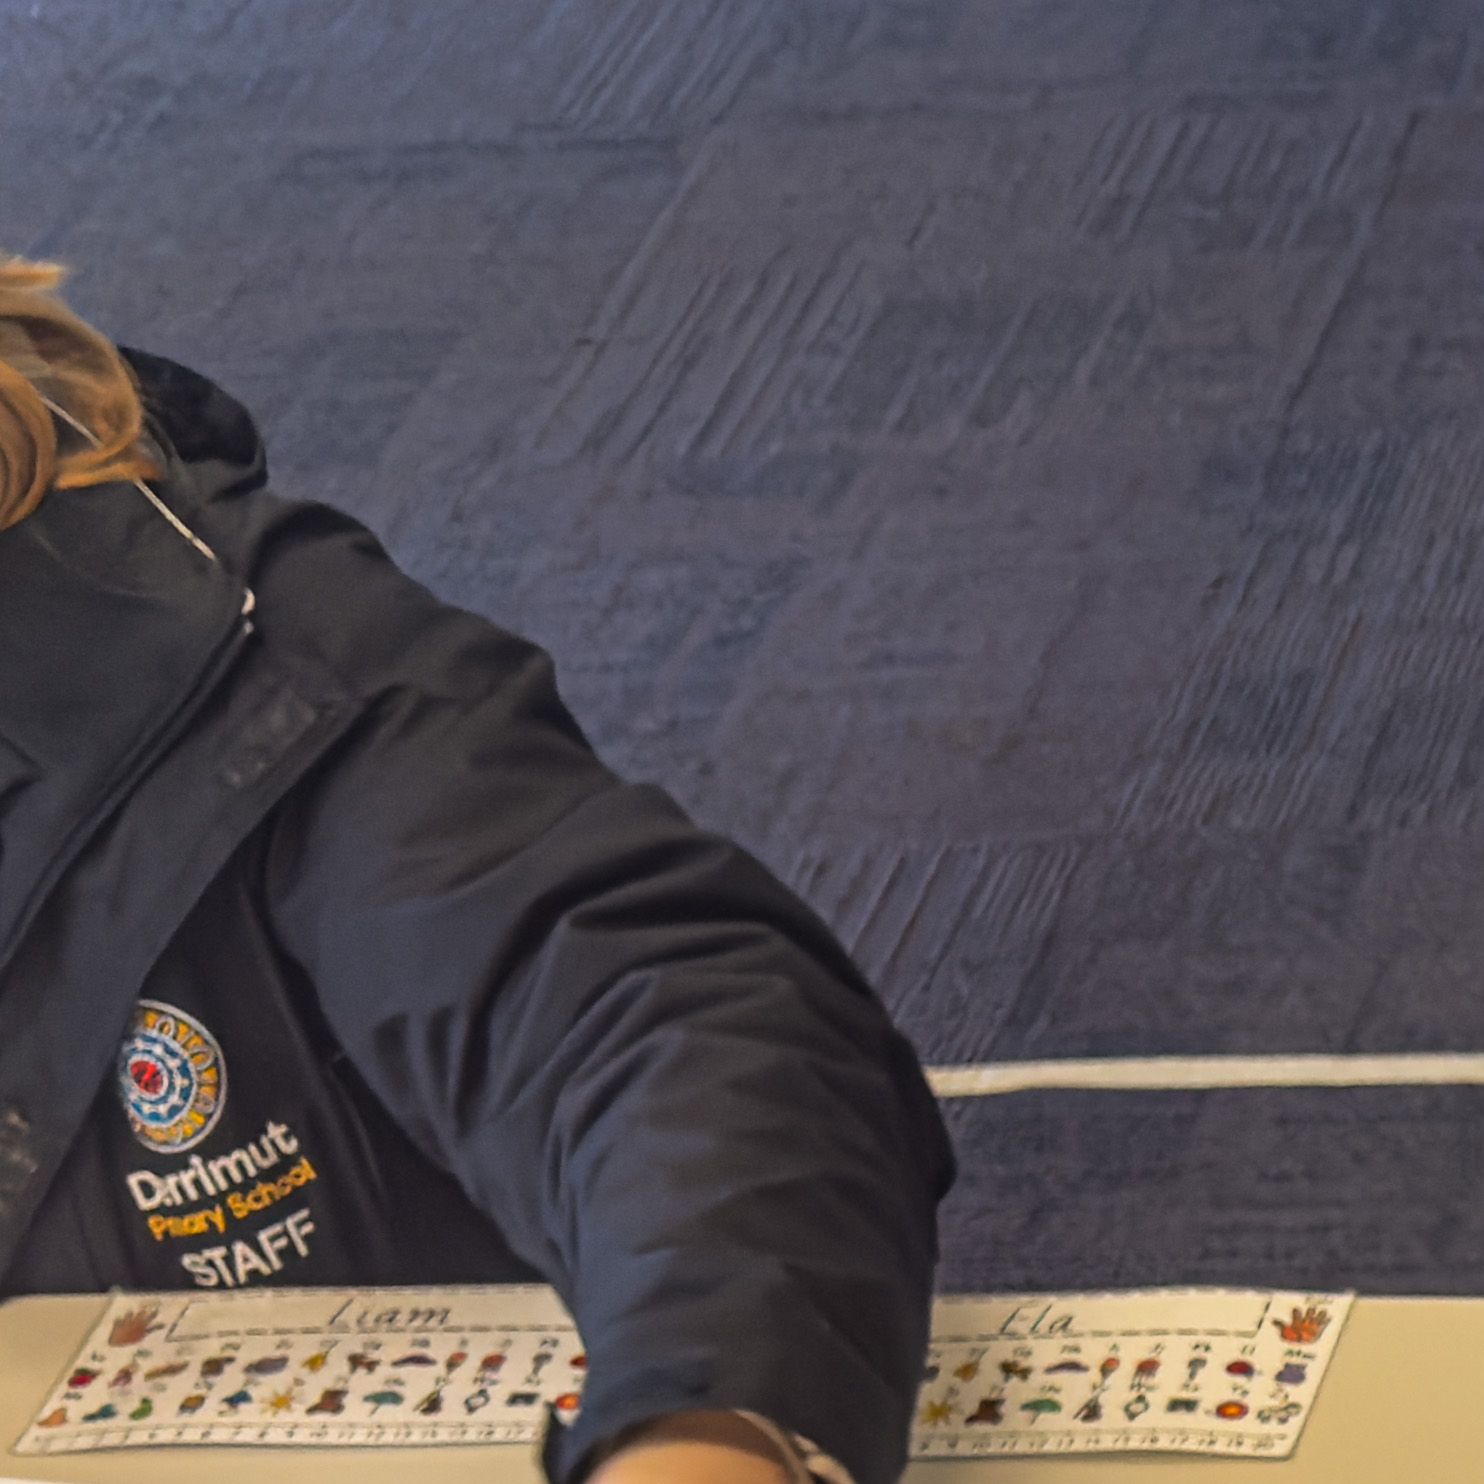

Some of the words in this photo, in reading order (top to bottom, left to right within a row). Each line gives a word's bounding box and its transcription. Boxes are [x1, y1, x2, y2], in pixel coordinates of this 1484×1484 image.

[181, 1208, 315, 1288] STAFF
[328, 1298, 452, 1328] Liam
[1000, 1303, 1074, 1337] Ela
